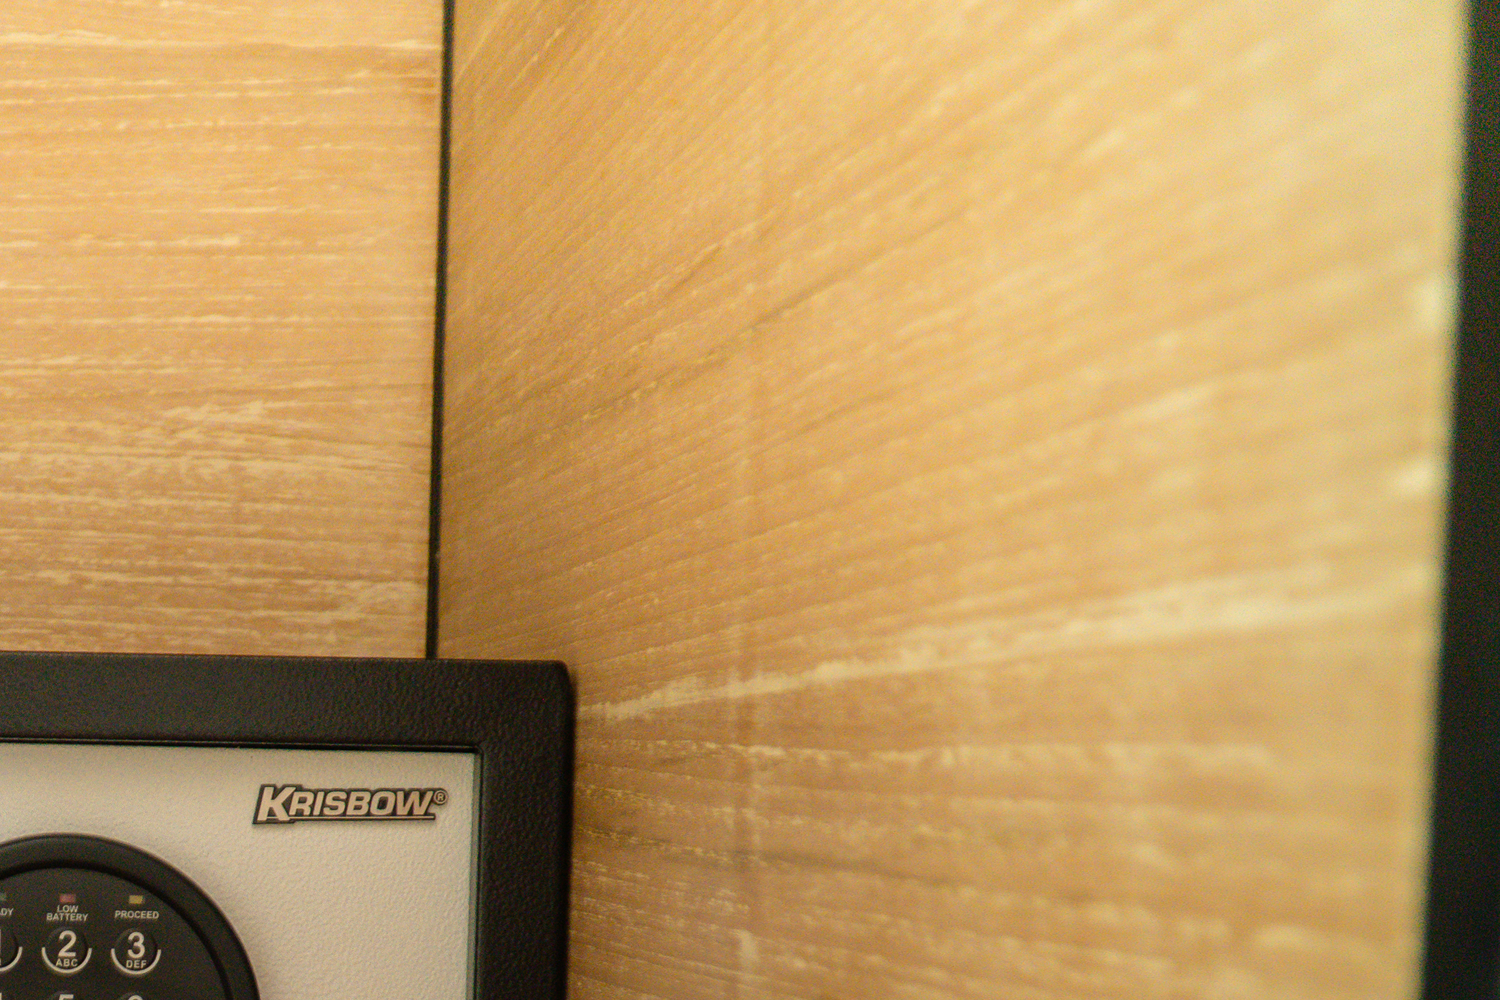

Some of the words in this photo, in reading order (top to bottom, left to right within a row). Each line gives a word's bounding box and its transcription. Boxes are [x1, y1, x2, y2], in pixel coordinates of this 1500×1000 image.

[56, 904, 79, 913] LOW
[46, 912, 89, 922] BATTERY
[114, 910, 160, 920] PROCEED
[58, 930, 77, 957] 2
[127, 932, 145, 959] 3
[55, 958, 78, 968] ABC
[125, 960, 147, 969] DEF
